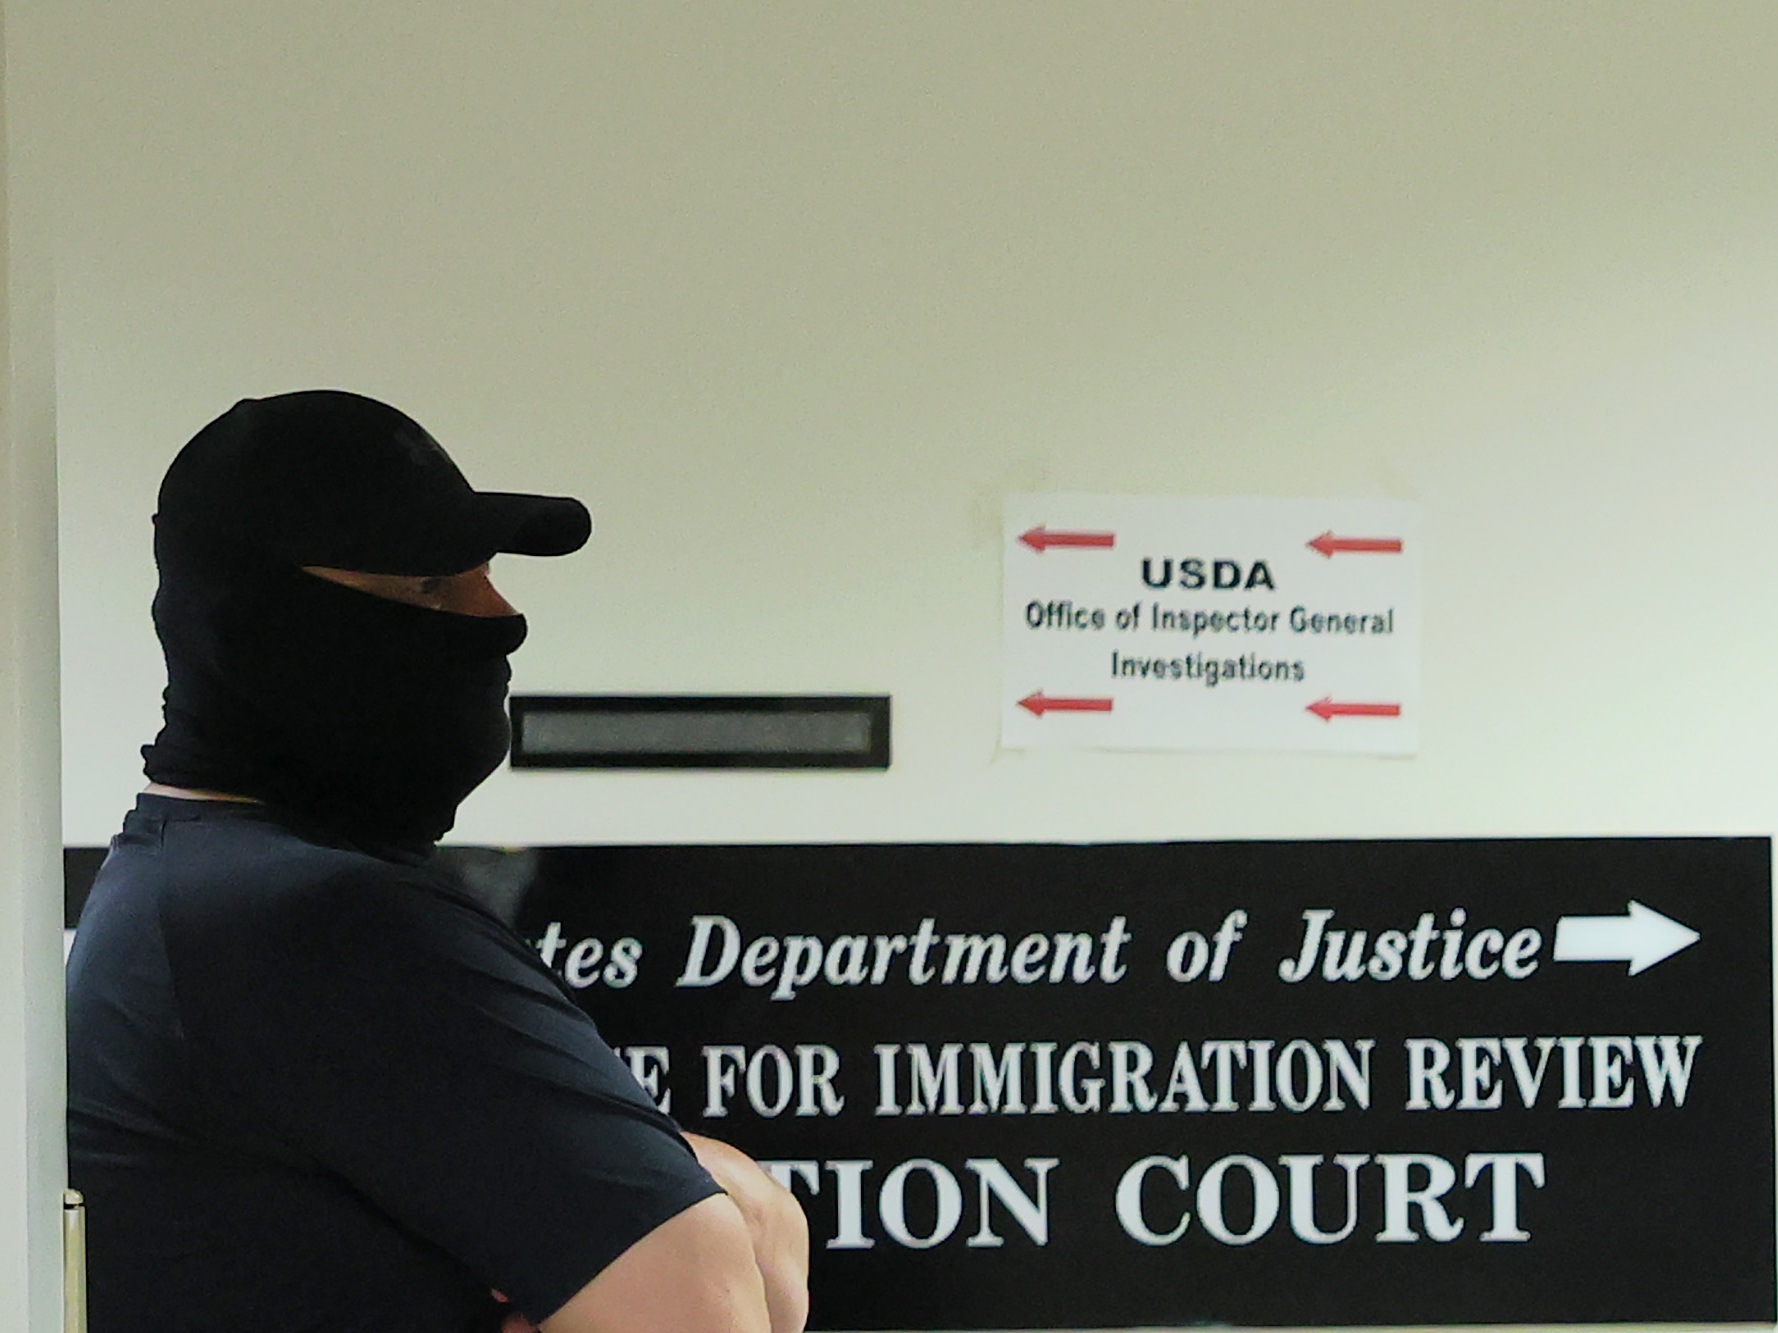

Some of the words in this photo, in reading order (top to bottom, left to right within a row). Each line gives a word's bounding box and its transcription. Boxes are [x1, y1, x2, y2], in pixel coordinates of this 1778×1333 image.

[1141, 557, 1276, 591] USDA
[1025, 600, 1106, 630] Office
[1116, 602, 1140, 631] of
[1152, 602, 1280, 638] Inspector
[1289, 606, 1395, 635] General
[1111, 650, 1306, 686] Investigations
[526, 921, 643, 989] tes
[674, 914, 1128, 1001] Department
[1166, 909, 1248, 983] of
[1279, 907, 1543, 983] Justice
[702, 1044, 845, 1118] FOR
[874, 1039, 1376, 1117] IMMIGRATION
[1404, 1035, 1703, 1112] REVIEW
[1114, 1152, 1546, 1248] COURT
